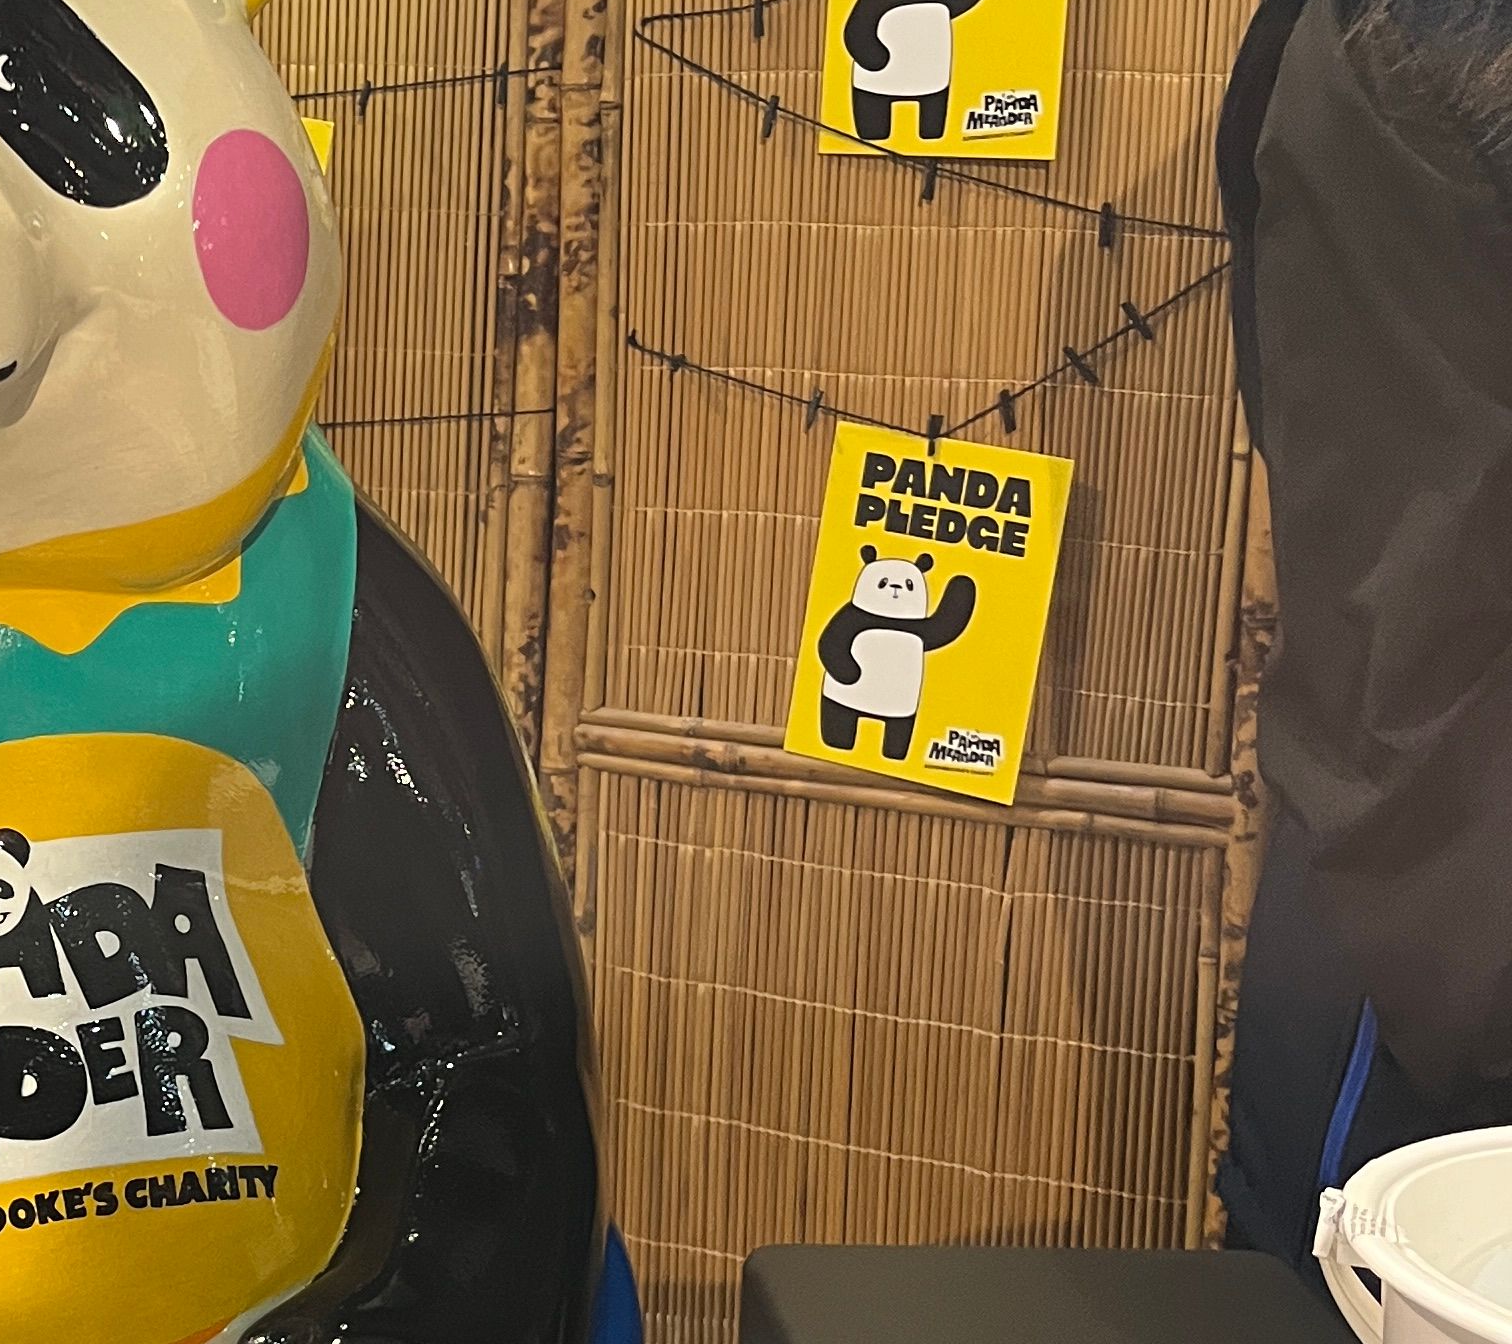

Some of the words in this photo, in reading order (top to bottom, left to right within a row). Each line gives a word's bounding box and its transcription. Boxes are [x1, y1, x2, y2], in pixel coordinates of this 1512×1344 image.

[984, 94, 1038, 115] PANDA
[861, 451, 1031, 517] PANDA
[854, 494, 1029, 557] PLEDGE
[124, 1165, 279, 1218] CHARITY
